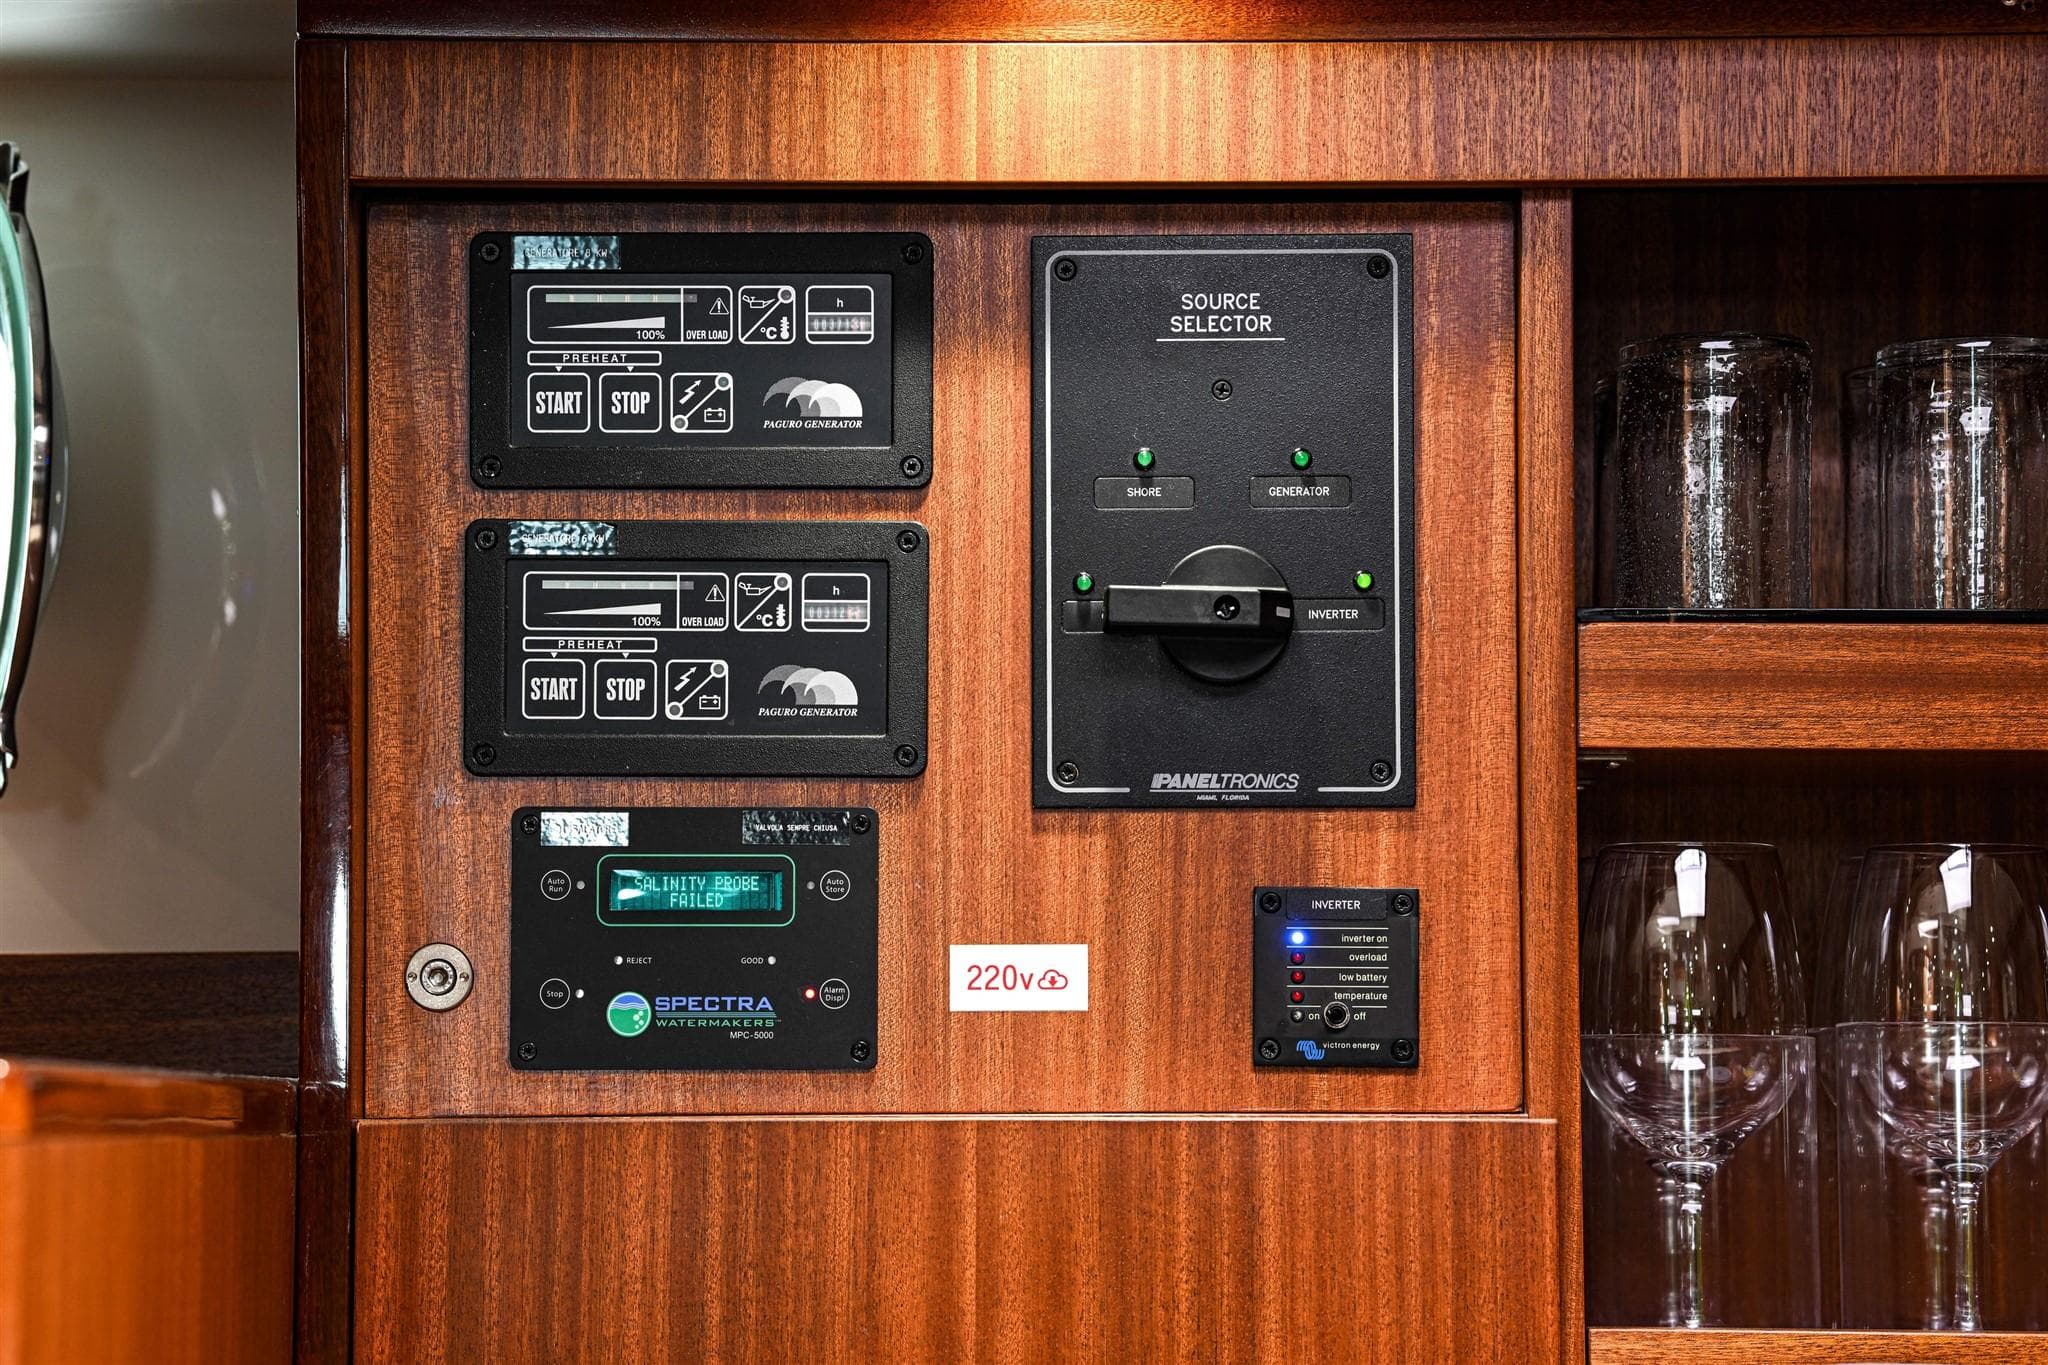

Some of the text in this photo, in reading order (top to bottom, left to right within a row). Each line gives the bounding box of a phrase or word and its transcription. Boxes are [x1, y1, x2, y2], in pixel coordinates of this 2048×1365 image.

[524, 247, 580, 258] GENERATORE
[596, 248, 608, 258] KW
[836, 297, 844, 308] h
[1181, 293, 1261, 311] SOURCE
[1170, 315, 1272, 332] SELECTOR
[636, 329, 666, 340] 100%
[686, 329, 728, 340] OVER LOAD
[562, 353, 627, 363] PREHEAT
[535, 391, 583, 415] START
[611, 391, 650, 415] STOP
[763, 419, 863, 430] PAGURO GENERATOR
[1126, 487, 1162, 498] SHORE
[1268, 486, 1330, 497] GENERATOR
[832, 585, 840, 596] h
[1308, 608, 1359, 620] INVERTER
[632, 616, 662, 627] 100%
[681, 616, 724, 627] OVER LOAD
[557, 639, 623, 650] PREHEAT
[530, 678, 578, 701] START
[606, 678, 646, 702] STOP
[758, 707, 858, 718] PAGURO GENERATOR
[1150, 773, 1300, 789] PANELTRONICS
[754, 823, 838, 832] VALVOLA SEMPRE CHIUSA
[547, 878, 566, 886] Auto
[634, 876, 760, 891] SALINITY PROBE
[826, 877, 845, 886] Auto
[549, 885, 563, 893] Run
[825, 885, 845, 894] Store
[670, 893, 724, 908] FAILED
[1311, 900, 1361, 910] INVERTER
[1341, 933, 1376, 943] inverter
[626, 956, 652, 965] REJECT
[740, 956, 764, 965] GOOD
[1349, 952, 1387, 962] overload
[967, 964, 1034, 990] 220v
[1338, 972, 1387, 984] low battery
[546, 990, 564, 999] Stop
[824, 986, 846, 995] Alarm
[825, 993, 844, 1003] Displ
[1334, 991, 1388, 1002] temperature
[655, 996, 774, 1011] SPECTRA
[1308, 1012, 1320, 1020] on
[1353, 1011, 1367, 1021] off
[656, 1019, 775, 1028] WATERMAKERS
[729, 1031, 774, 1039] MPC-5000
[1322, 1041, 1380, 1050] victron energy
